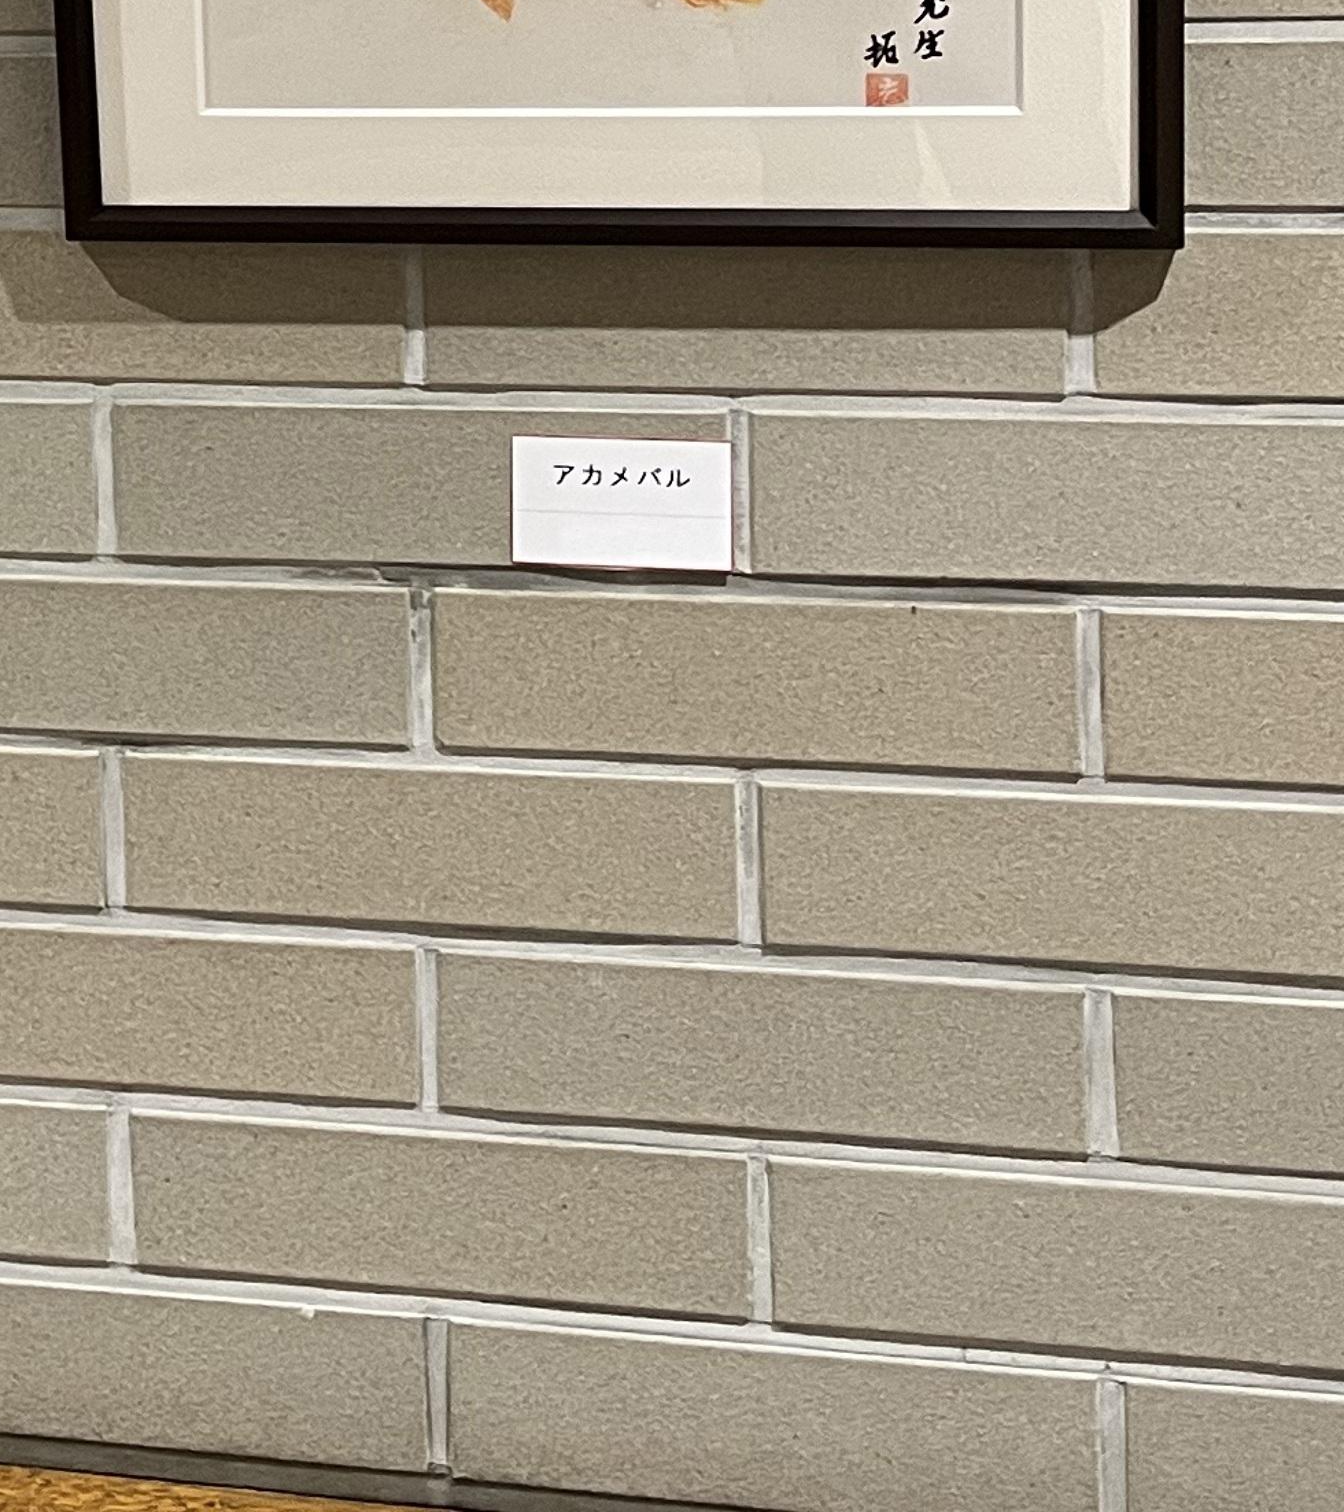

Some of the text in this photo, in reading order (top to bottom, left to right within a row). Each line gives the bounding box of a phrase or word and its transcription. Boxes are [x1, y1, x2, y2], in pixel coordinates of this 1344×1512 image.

[552, 463, 691, 488] アカメバル
